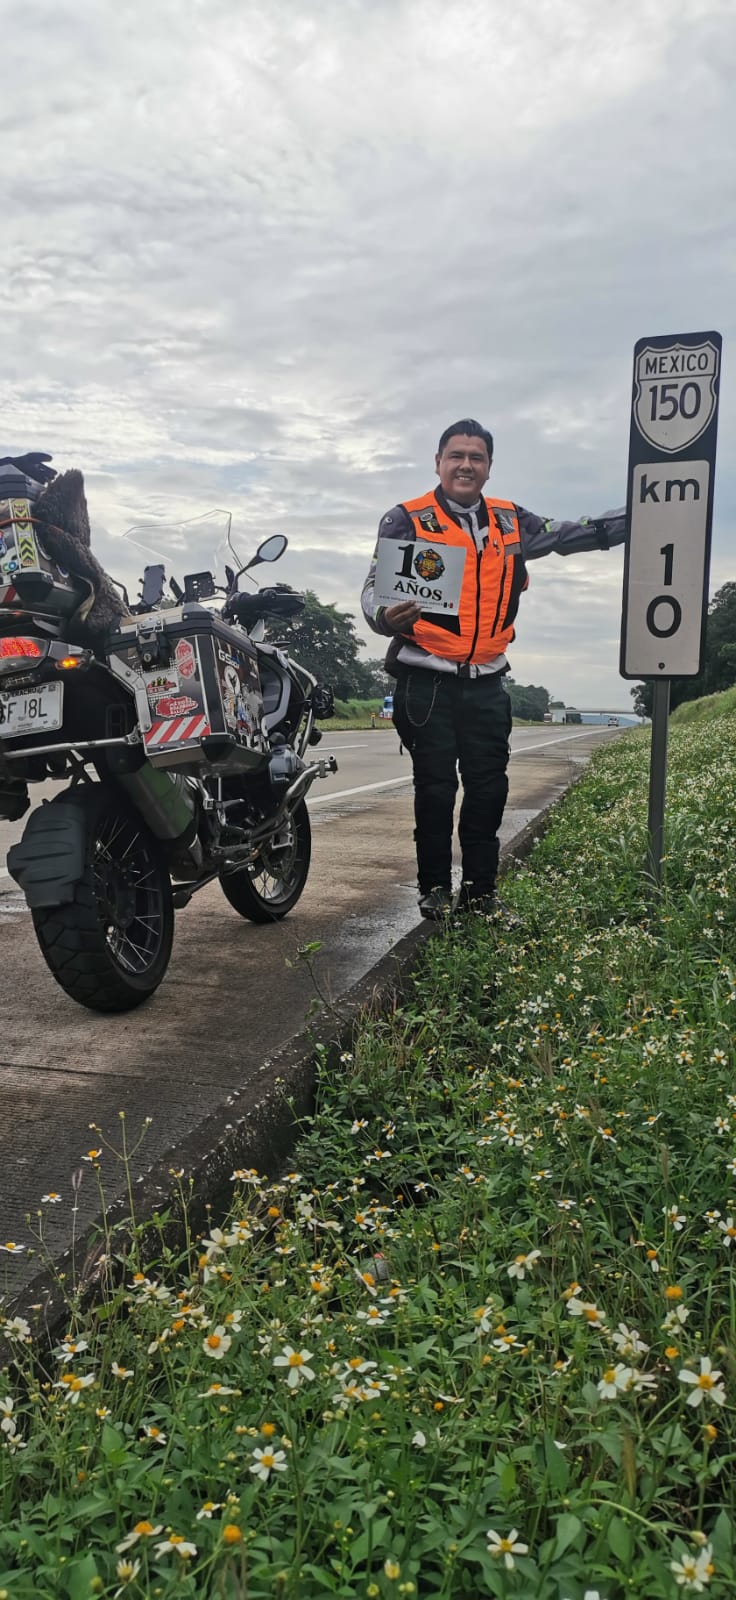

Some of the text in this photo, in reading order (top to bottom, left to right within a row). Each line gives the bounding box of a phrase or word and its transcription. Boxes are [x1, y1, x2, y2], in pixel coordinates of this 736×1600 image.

[645, 352, 709, 375] MEXICO
[649, 382, 702, 421] 150
[639, 474, 701, 503] km
[393, 579, 443, 601] AÑOS
